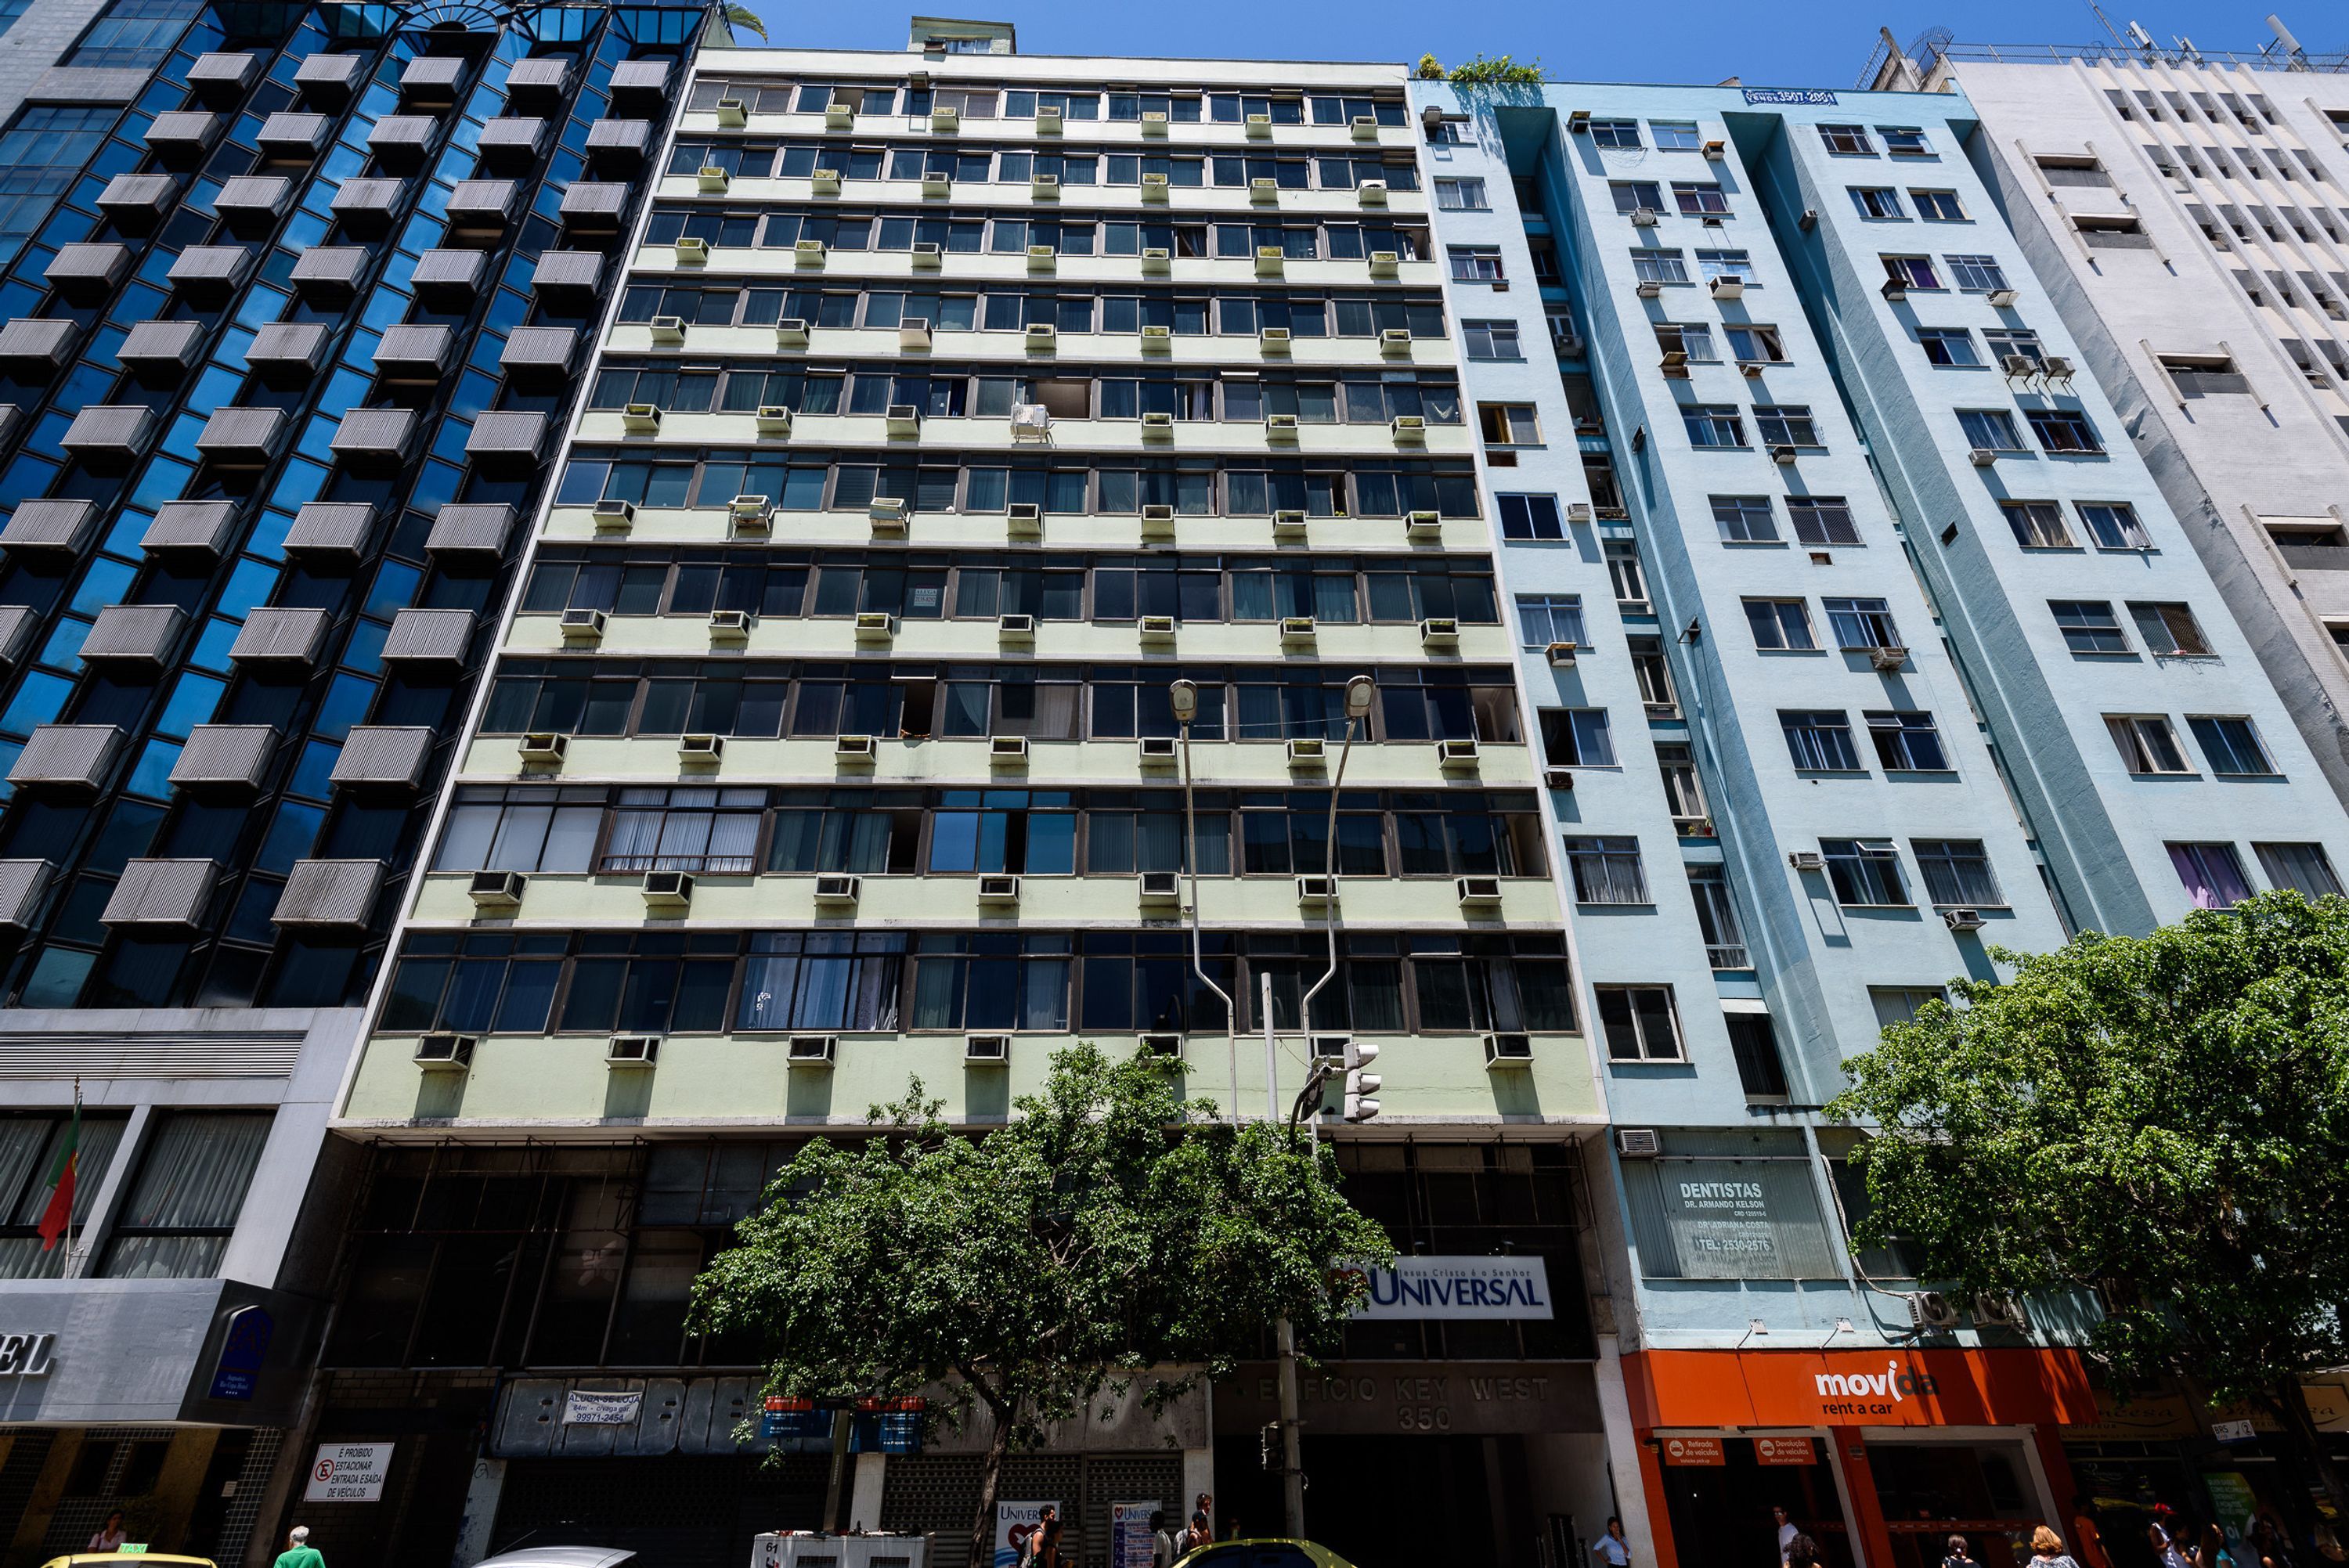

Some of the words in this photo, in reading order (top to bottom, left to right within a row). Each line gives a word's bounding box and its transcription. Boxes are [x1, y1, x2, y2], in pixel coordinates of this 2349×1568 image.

[1680, 1183, 1762, 1198] DENTISTAS
[1699, 1239, 1721, 1251] TEL:
[1723, 1240, 1770, 1252] 2530-2576
[1400, 1269, 1427, 1279] Jesus
[1433, 1269, 1467, 1278] Cristo
[1471, 1269, 1478, 1278] é
[1492, 1269, 1531, 1278] Senhor
[1369, 1268, 1545, 1307] UNIVERSAL
[1814, 1360, 1941, 1402] movida
[1395, 1378, 1448, 1401] KEY
[1469, 1378, 1548, 1401] WEST
[568, 1394, 615, 1404] ALUGA-SE
[616, 1395, 640, 1404] LOJA
[1823, 1402, 1856, 1415] rent
[1858, 1404, 1867, 1415] a
[1870, 1404, 1893, 1415] car
[576, 1413, 624, 1422] 99971-2454
[1398, 1406, 1451, 1430] 350
[2214, 1425, 2228, 1434] BRS
[1775, 1440, 1806, 1449] Devolução
[338, 1447, 345, 1458] É
[344, 1447, 373, 1458] PROIBIDO
[335, 1461, 373, 1471] ESTACIONAR
[330, 1474, 359, 1484] ENTRADA
[327, 1488, 336, 1498] DE
[336, 1486, 366, 1498] VEÍCULOS
[120, 1543, 148, 1554] TAXI
[766, 1542, 778, 1554] 61
